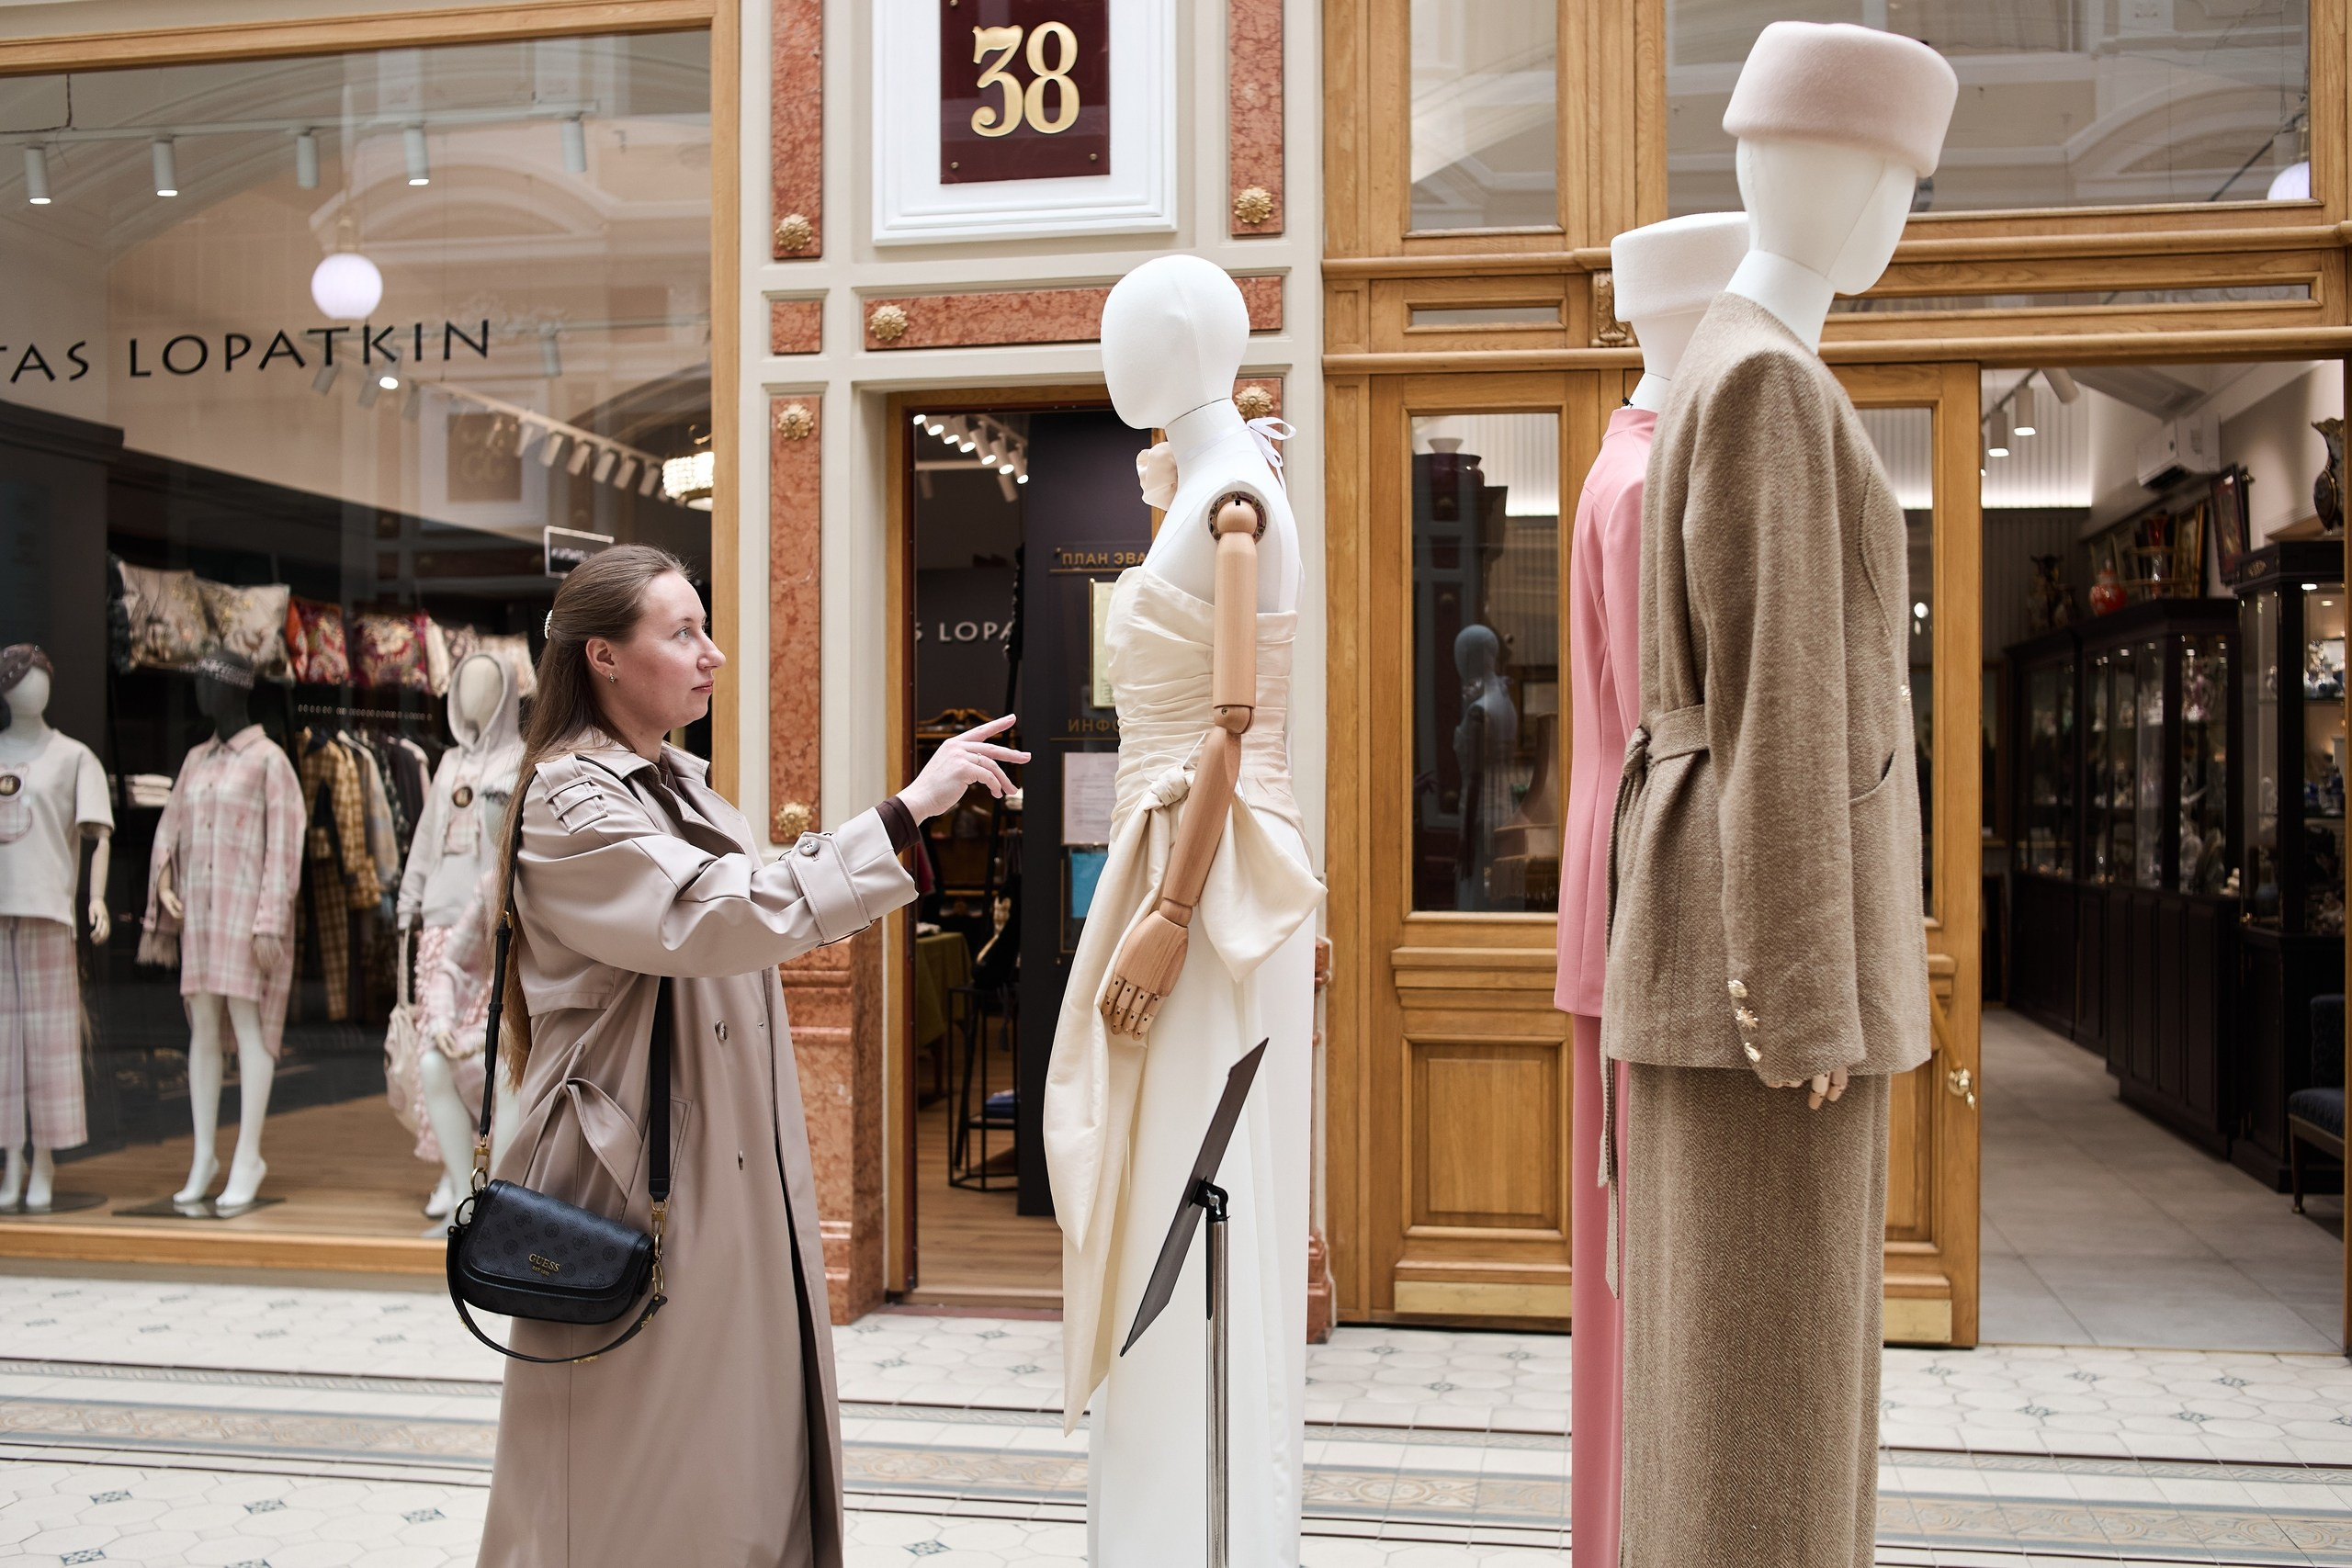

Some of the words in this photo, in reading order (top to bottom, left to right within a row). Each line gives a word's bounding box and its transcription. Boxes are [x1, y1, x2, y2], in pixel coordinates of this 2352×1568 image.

[970, 20, 1080, 138] 38
[0, 340, 89, 384] AS
[129, 319, 490, 378] LOPATKIN
[1062, 552, 1108, 566] ПЛАН
[529, 1253, 560, 1272] GUESS
